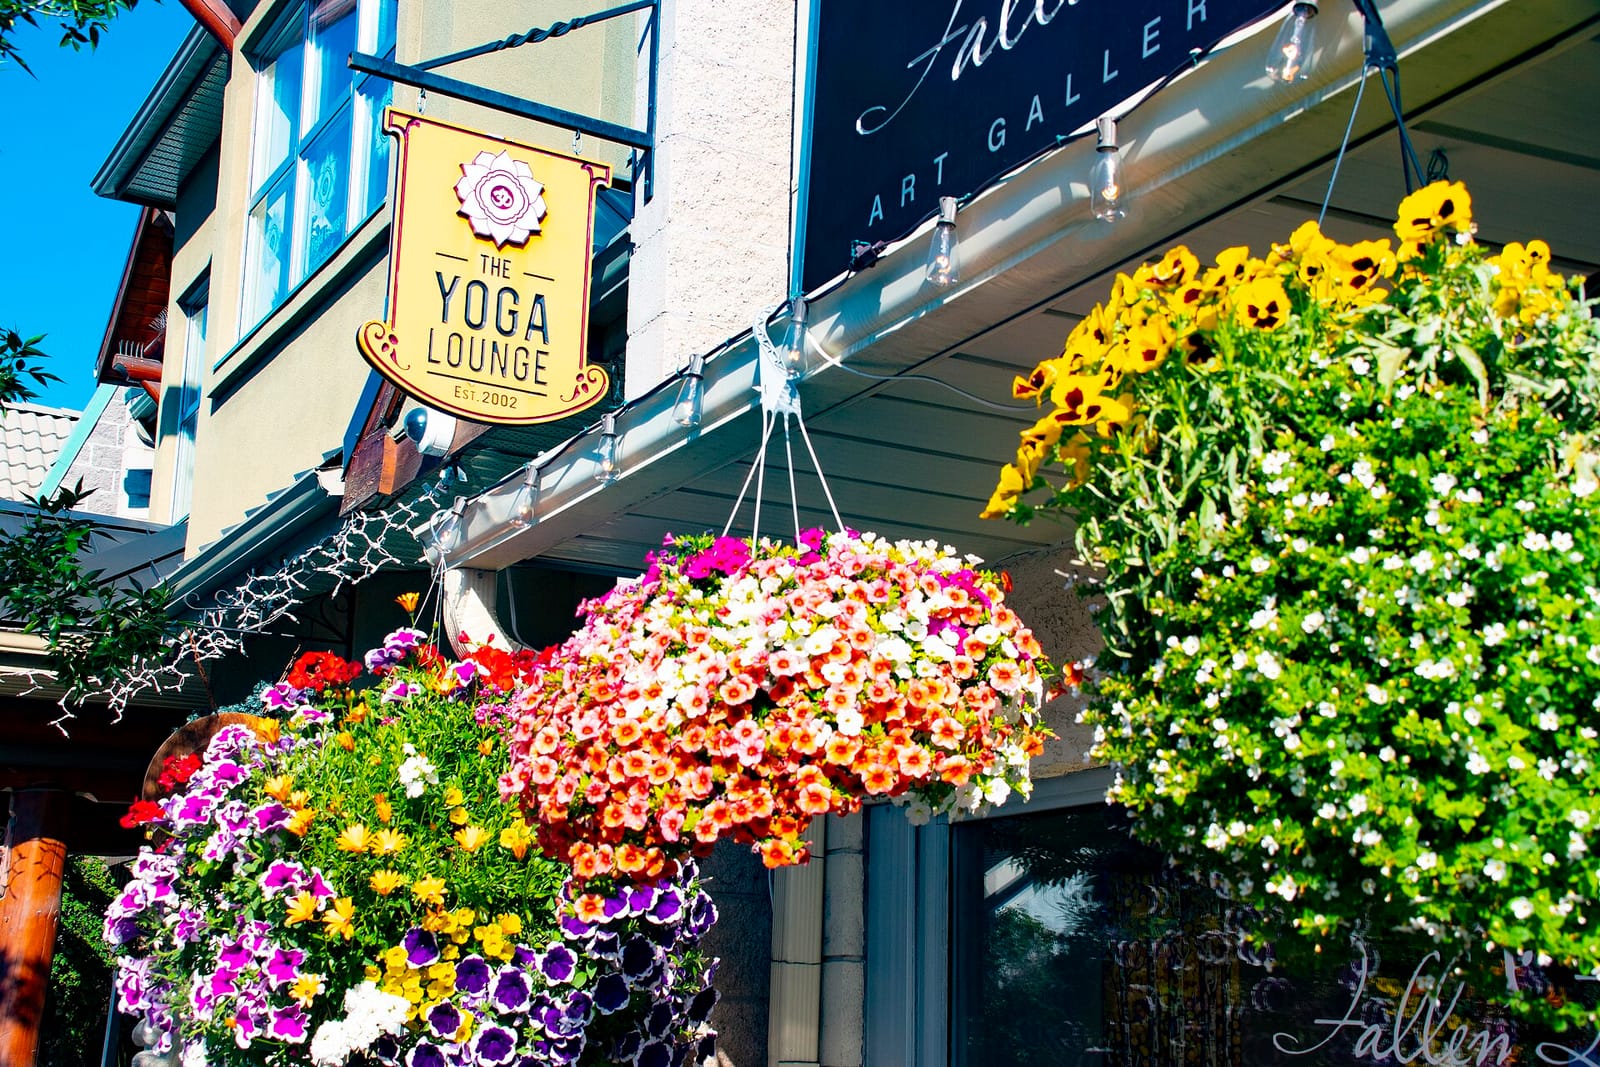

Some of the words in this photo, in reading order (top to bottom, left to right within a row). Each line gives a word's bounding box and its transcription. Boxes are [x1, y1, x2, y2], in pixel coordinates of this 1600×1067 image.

[868, 151, 948, 227] ART
[480, 253, 512, 280] THE
[435, 270, 550, 345] YOGA
[427, 326, 549, 386] LOUNGE
